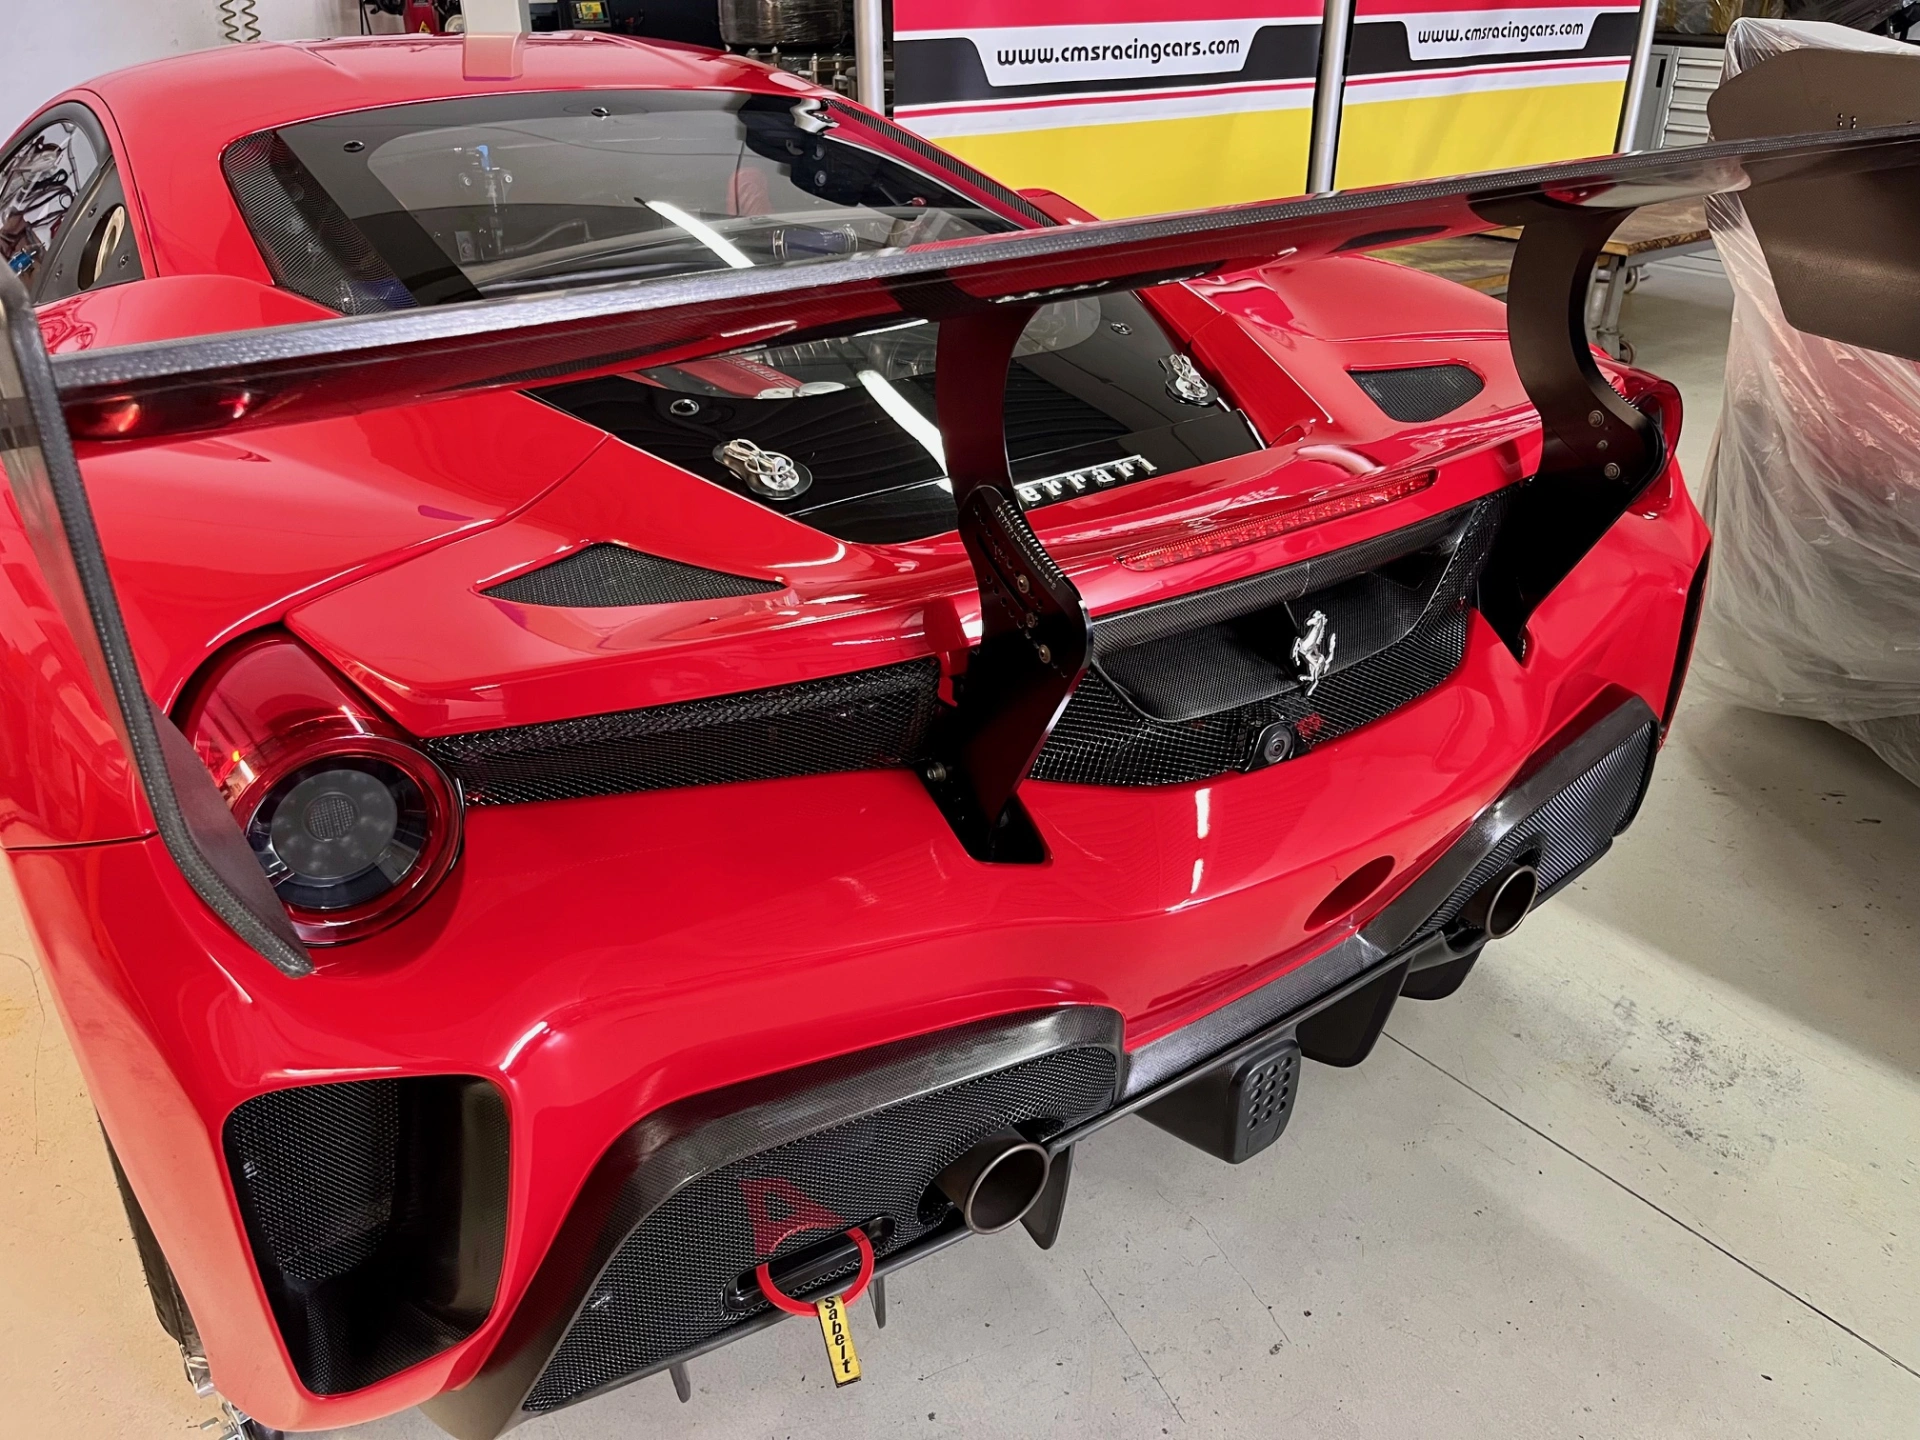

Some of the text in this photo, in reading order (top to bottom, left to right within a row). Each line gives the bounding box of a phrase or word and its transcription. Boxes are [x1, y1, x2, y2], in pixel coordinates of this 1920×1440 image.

[1418, 21, 1584, 44] www.cmsracingcars.com
[997, 38, 1240, 66] www.cmsracingcars.com
[1014, 454, 1158, 503] errari
